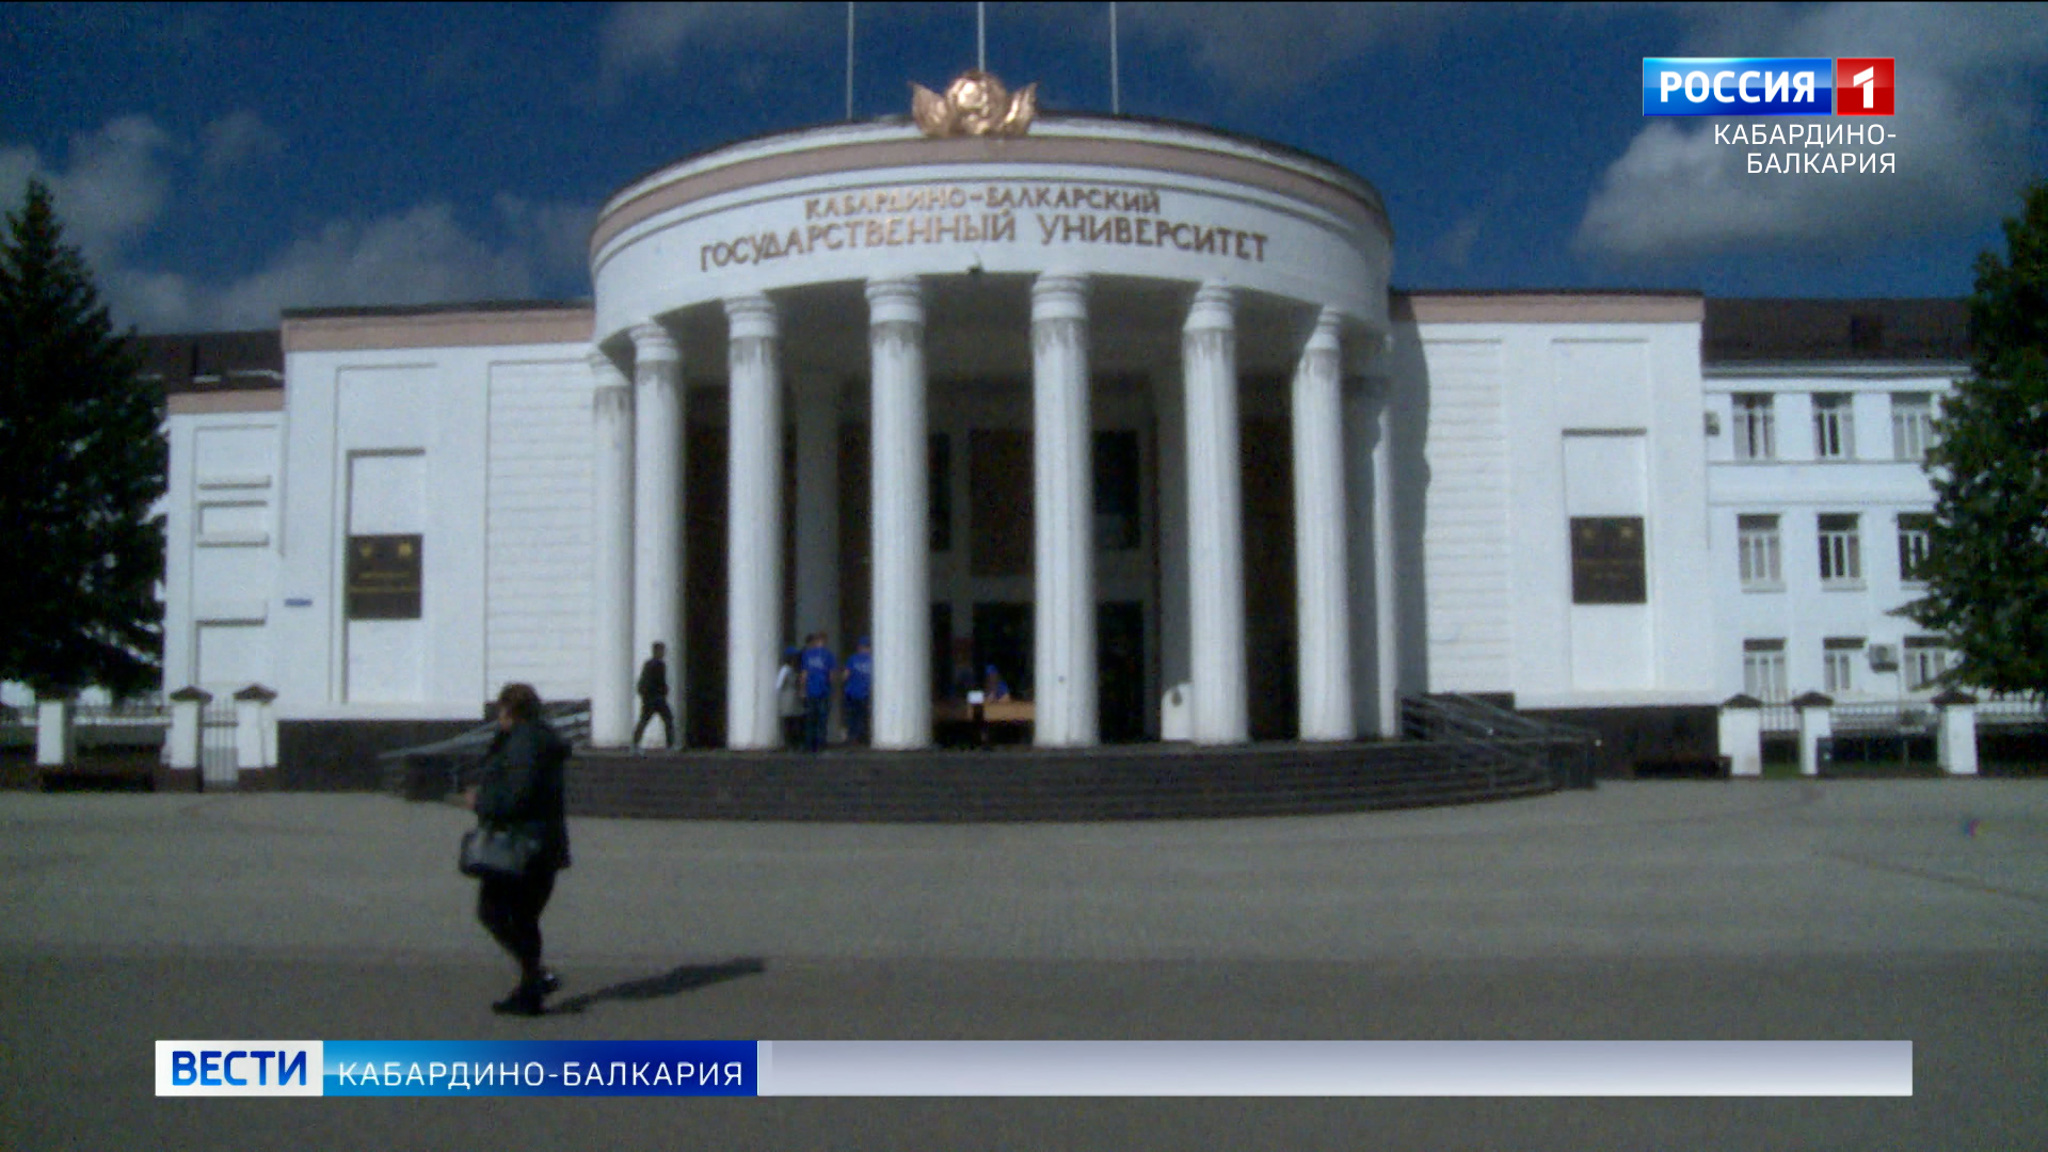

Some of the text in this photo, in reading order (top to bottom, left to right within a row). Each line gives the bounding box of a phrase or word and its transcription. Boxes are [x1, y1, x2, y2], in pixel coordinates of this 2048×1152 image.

[804, 186, 1161, 221] КАБАРДИНО-БАЛКАРСКИЙ
[700, 211, 1269, 271] ГОСУДАРСТВЕННЫЙ УНИВЕРСИТЕТ
